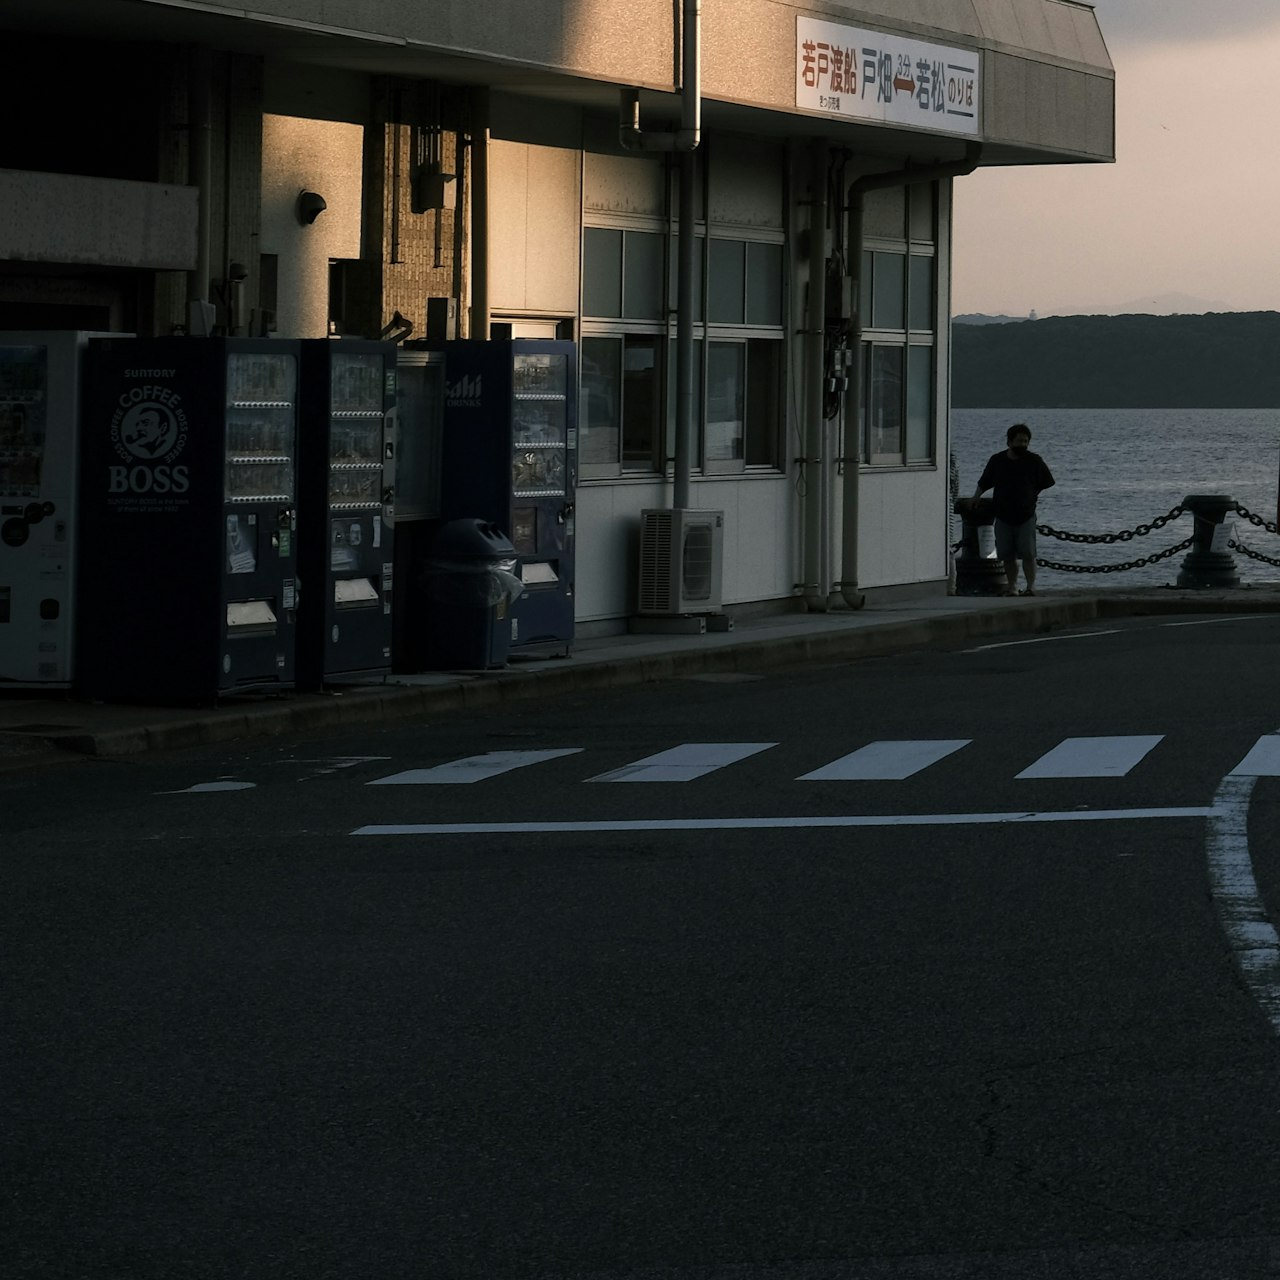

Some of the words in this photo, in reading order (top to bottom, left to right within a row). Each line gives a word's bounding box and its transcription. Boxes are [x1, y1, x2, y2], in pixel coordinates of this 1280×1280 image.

[802, 39, 857, 95] 若戸渡船
[861, 47, 892, 104] 戸畑
[897, 53, 911, 78] 3分
[916, 57, 945, 114] 若松
[947, 76, 974, 107] のりば
[119, 385, 182, 409] COFFEE
[107, 465, 190, 493] BOSS
